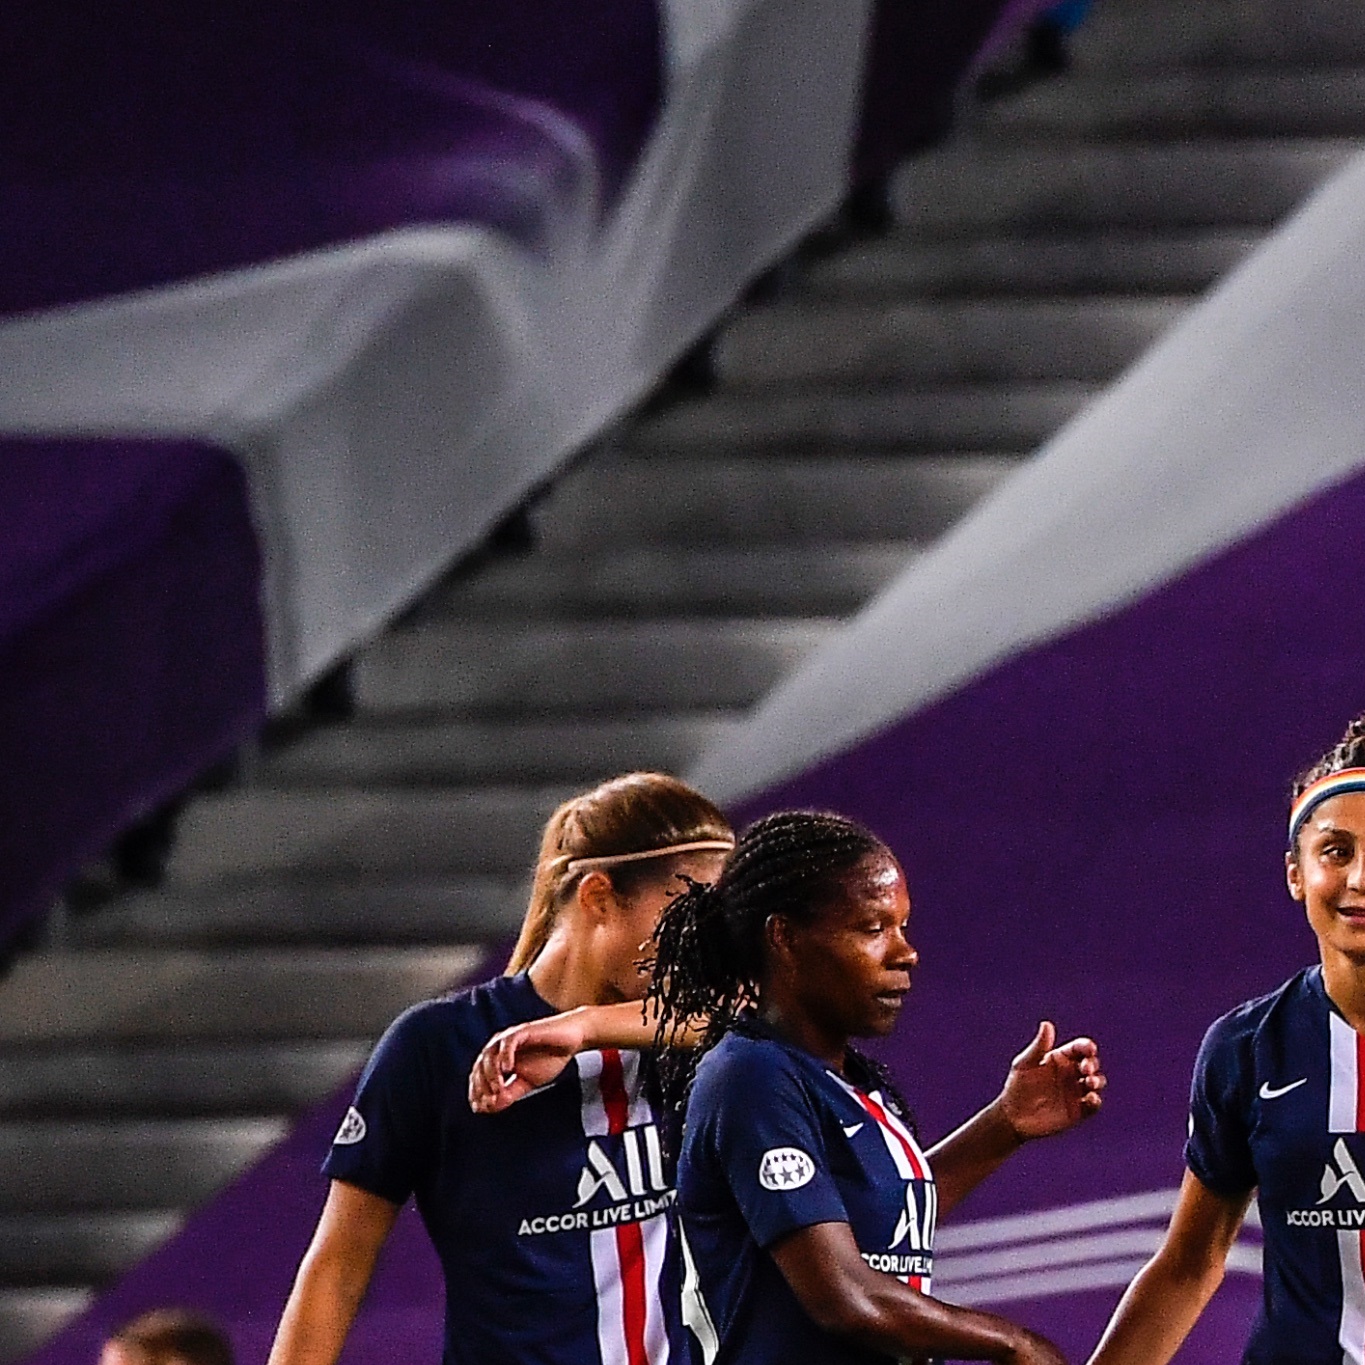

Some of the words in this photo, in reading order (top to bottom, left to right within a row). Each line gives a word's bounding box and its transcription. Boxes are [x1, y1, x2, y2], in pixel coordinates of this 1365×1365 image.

[518, 1211, 588, 1236] ACCOR
[593, 1203, 631, 1226] LIVE
[634, 1190, 678, 1218] LIMIT
